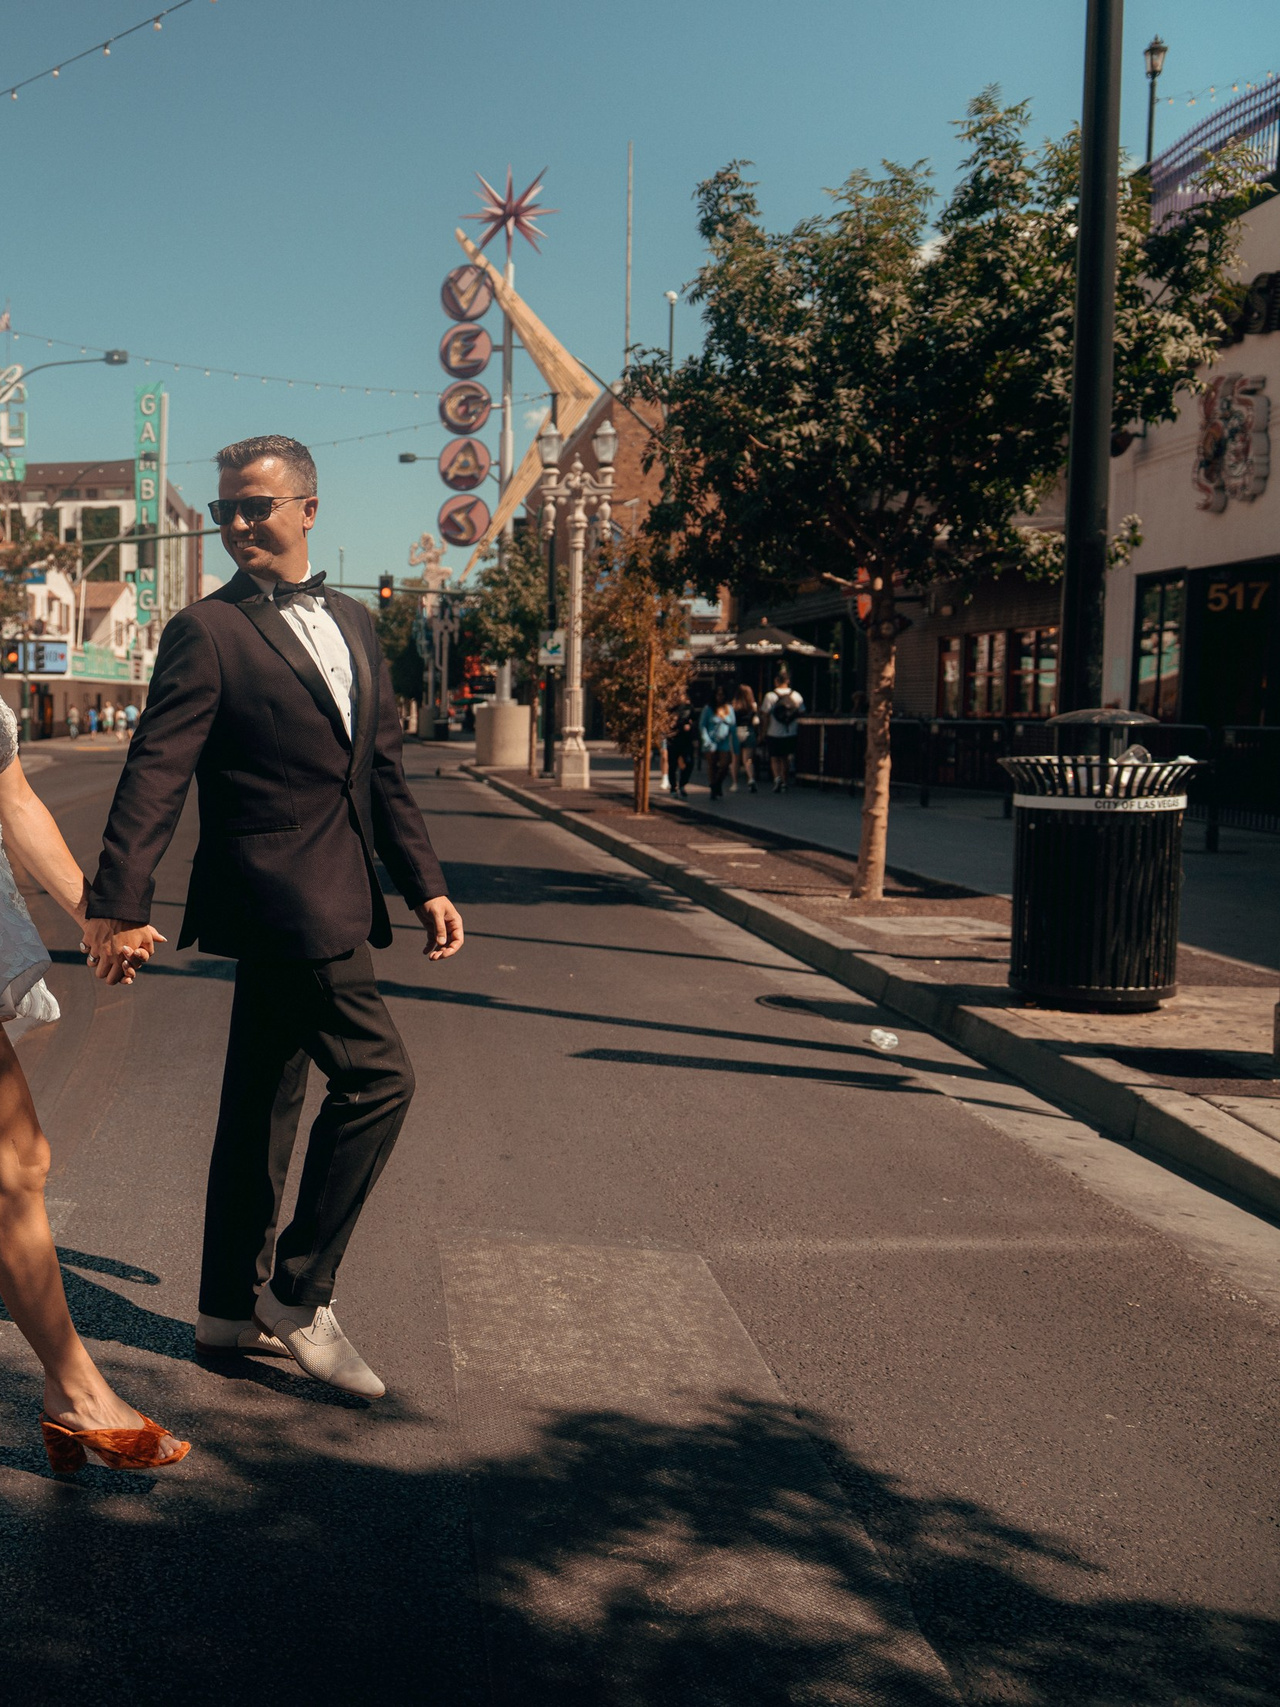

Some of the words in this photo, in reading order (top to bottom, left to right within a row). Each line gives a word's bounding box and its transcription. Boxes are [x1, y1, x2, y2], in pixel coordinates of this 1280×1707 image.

[440, 260, 491, 543] VEGAS
[139, 394, 157, 611] GAMBLNG
[1207, 582, 1270, 612] 517
[1094, 799, 1119, 809] CITY
[1121, 799, 1136, 809] OF
[1137, 799, 1156, 809] LAS
[1157, 798, 1180, 808] VEGAS
